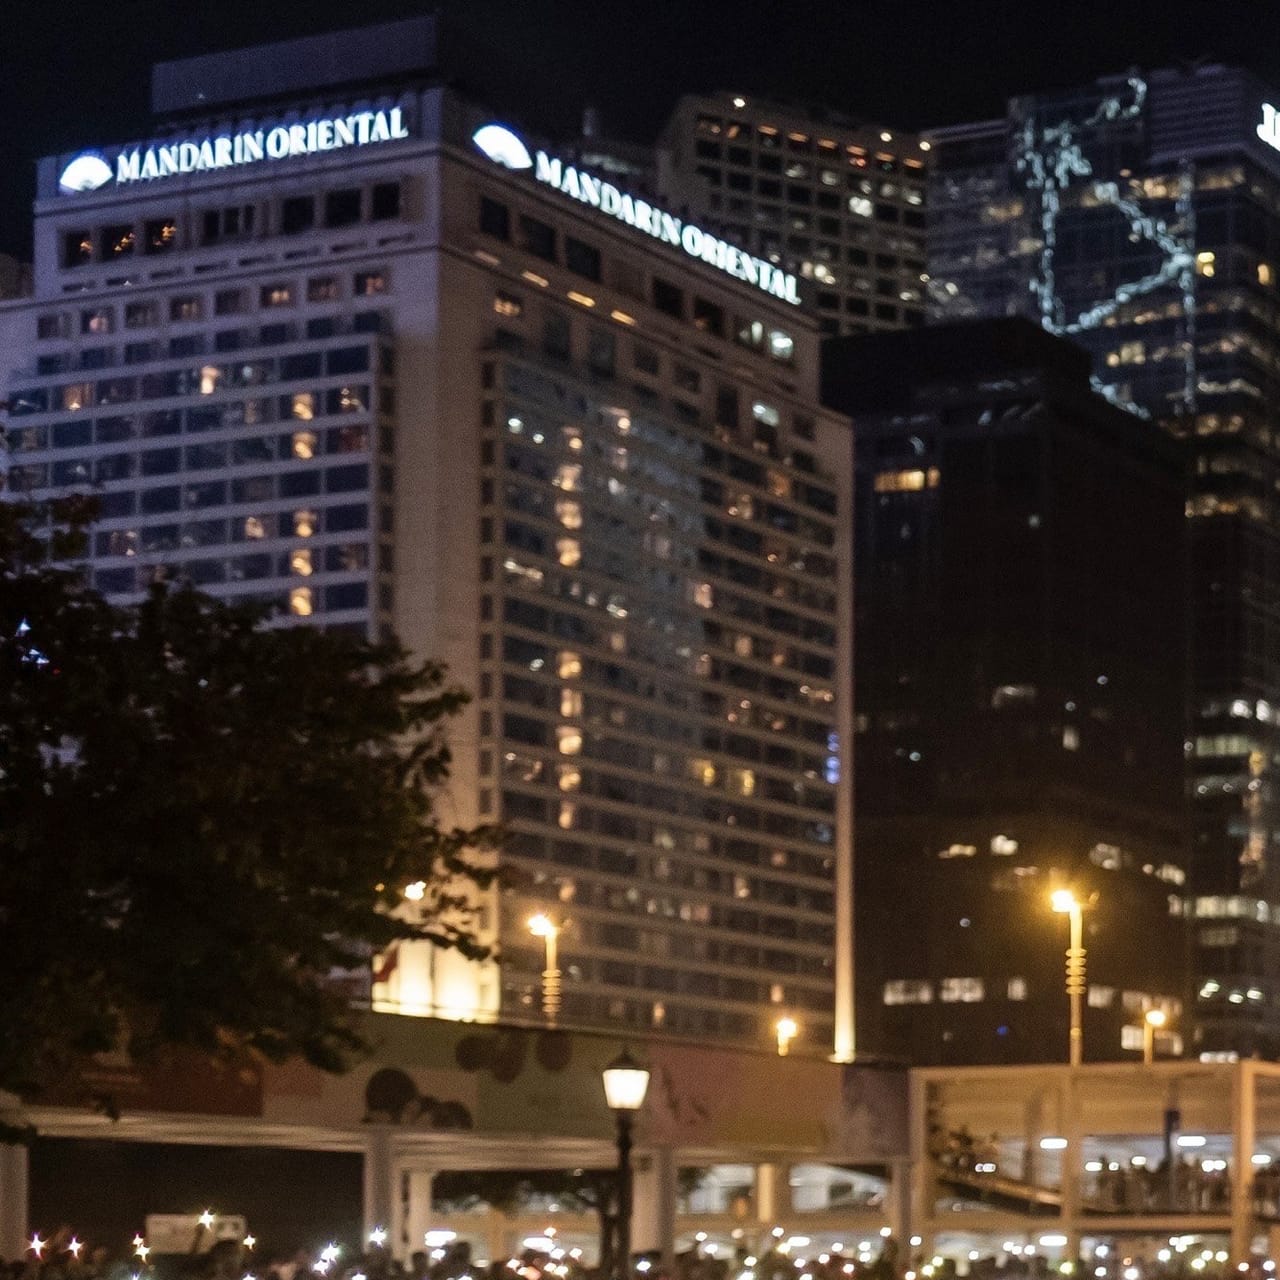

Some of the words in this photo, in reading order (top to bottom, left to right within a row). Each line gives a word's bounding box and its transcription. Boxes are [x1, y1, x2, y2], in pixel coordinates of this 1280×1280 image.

[116, 130, 265, 183] MANDARIN
[266, 106, 408, 158] ORIENTAL
[535, 150, 681, 246] MANDARIN
[682, 225, 802, 306] ORIENTAL
